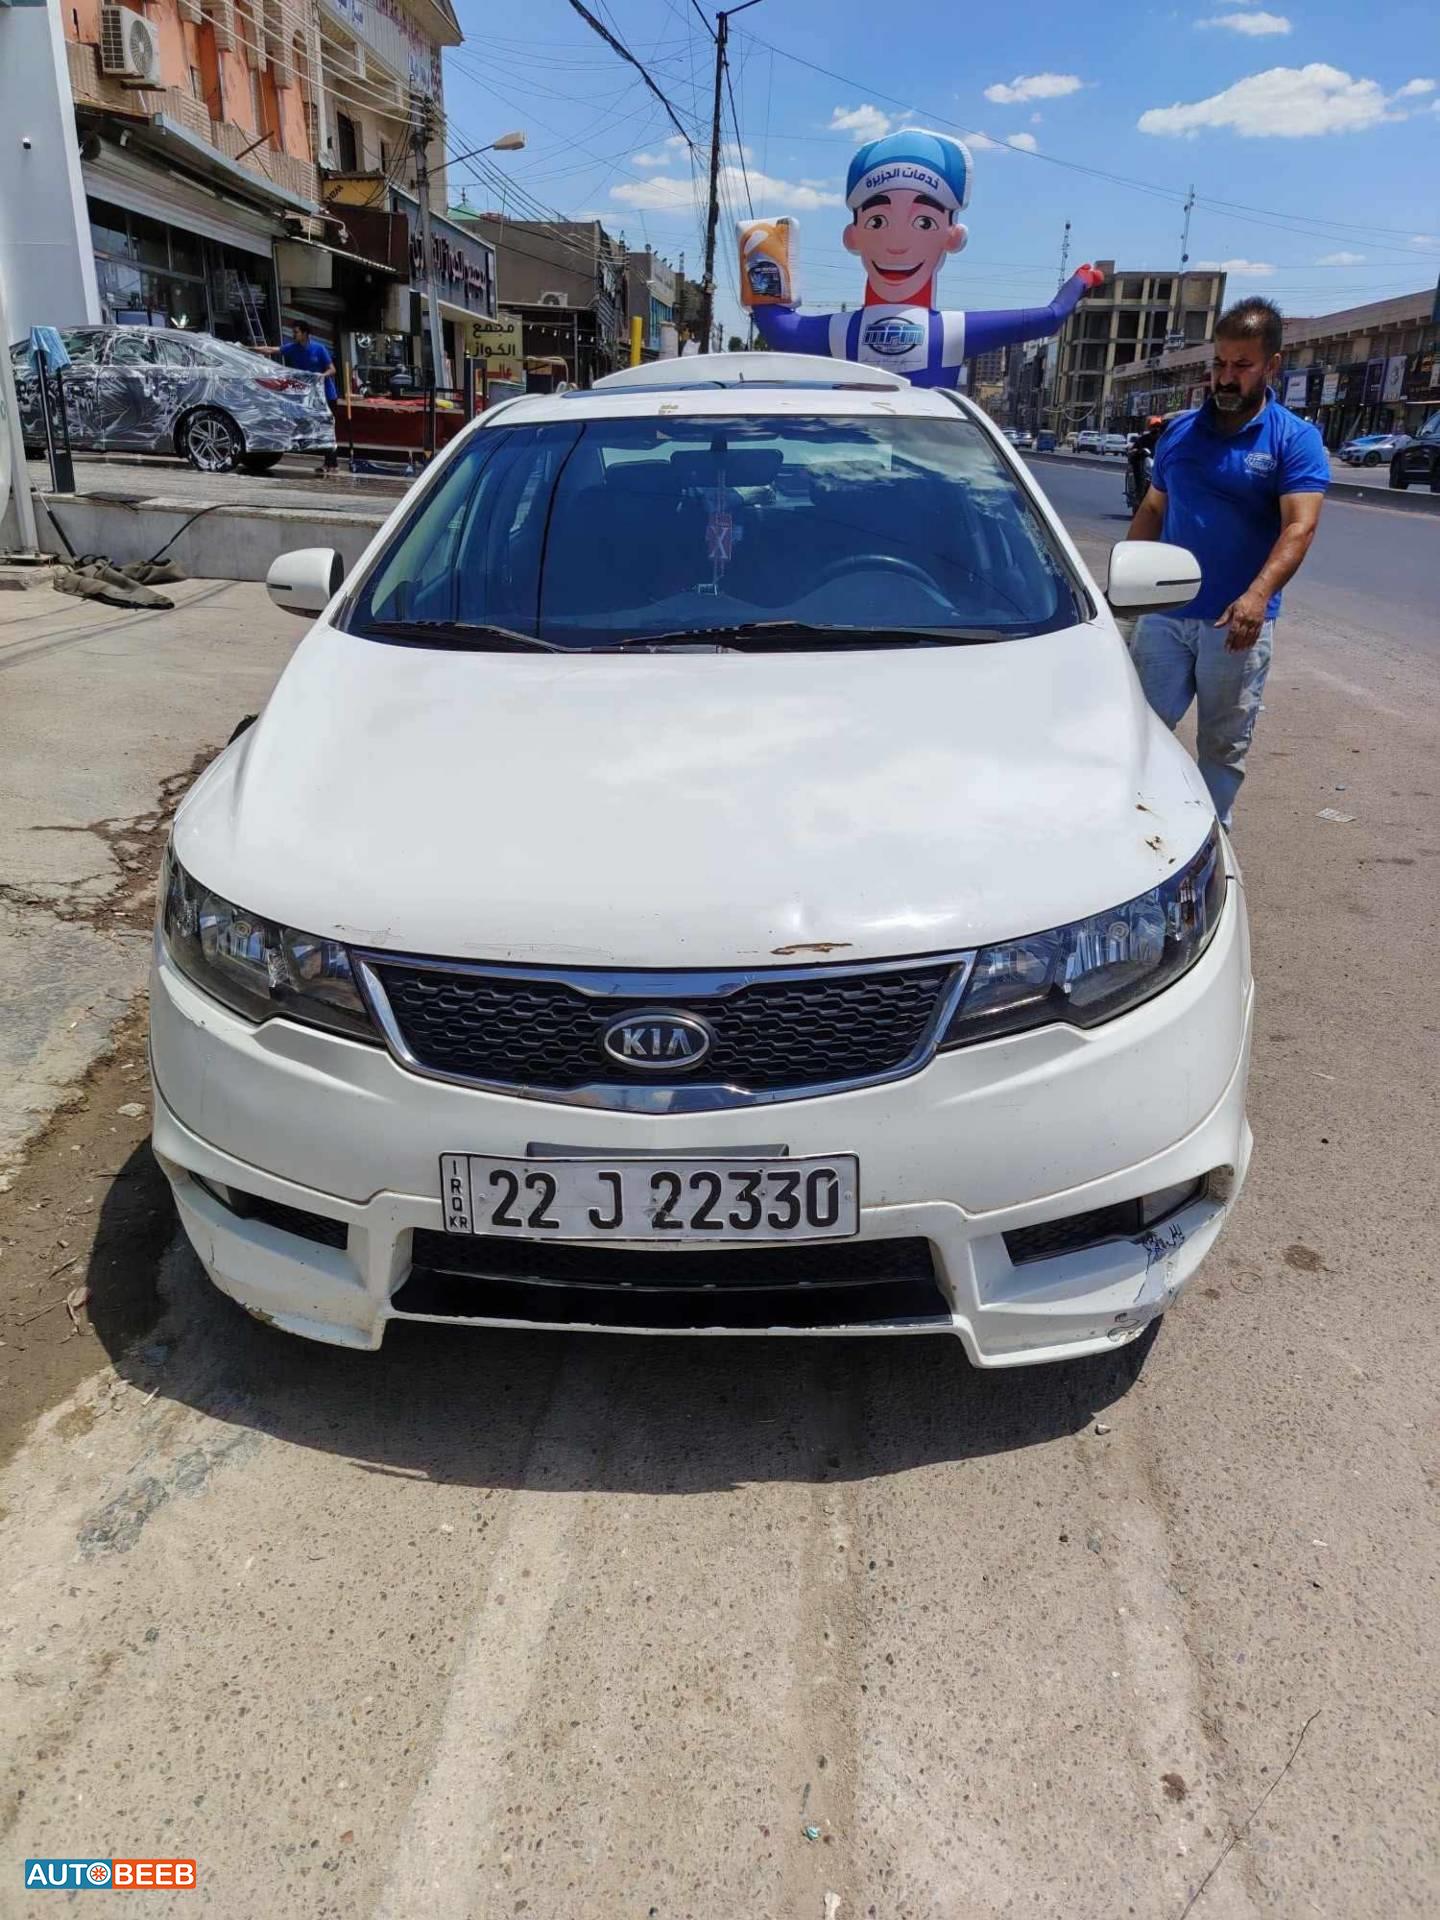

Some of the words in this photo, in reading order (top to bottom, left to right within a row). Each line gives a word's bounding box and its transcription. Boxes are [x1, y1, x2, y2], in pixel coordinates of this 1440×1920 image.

[866, 168, 899, 188] الجزيرة
[903, 167, 939, 189] خدمات
[473, 323, 514, 338] مجمع
[473, 343, 515, 358] الكواز
[622, 1028, 693, 1055] KIA
[489, 1169, 560, 1229] 22
[588, 1171, 623, 1229] J
[651, 1167, 839, 1230] 22330
[449, 1215, 468, 1228] KR
